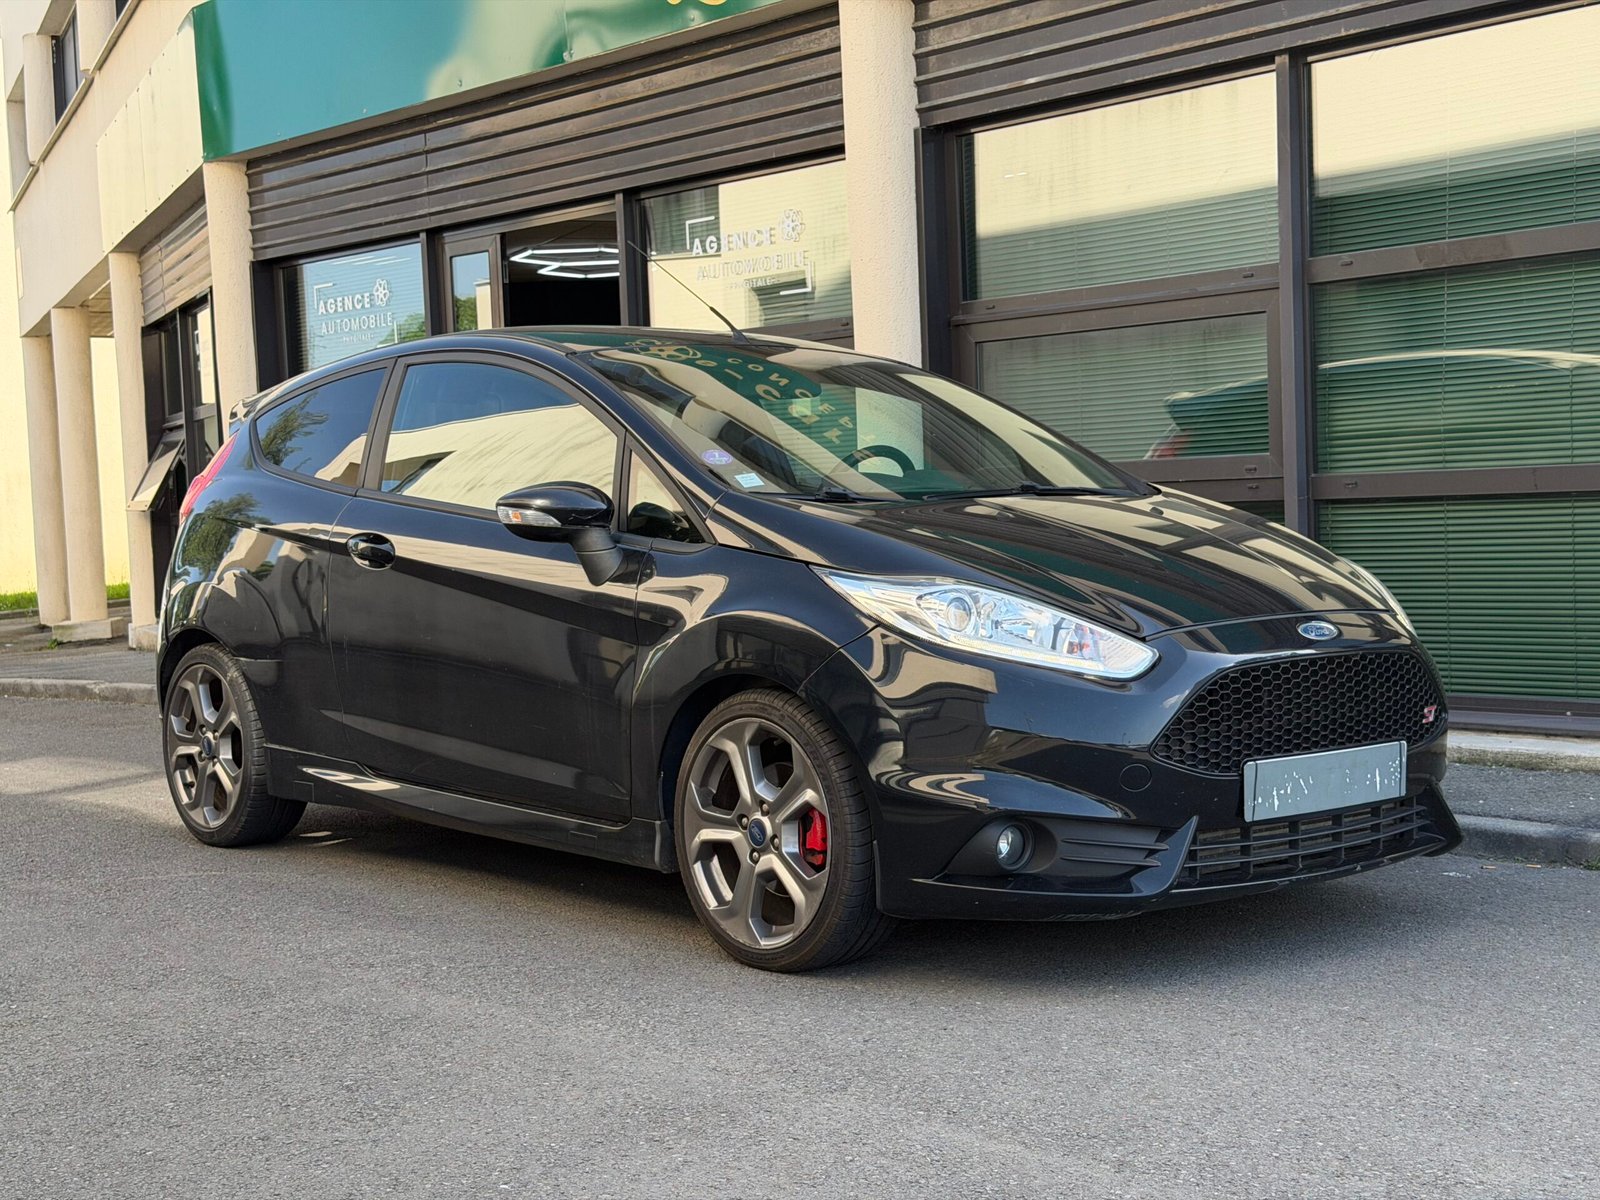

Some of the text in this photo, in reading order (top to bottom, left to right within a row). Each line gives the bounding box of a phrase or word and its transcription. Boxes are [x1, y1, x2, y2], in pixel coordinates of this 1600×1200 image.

[692, 227, 776, 256] AGENCE
[697, 250, 809, 281] AUTOMOBILE
[318, 293, 371, 315] AGENCE
[321, 312, 392, 335] AUTOMOBILE
